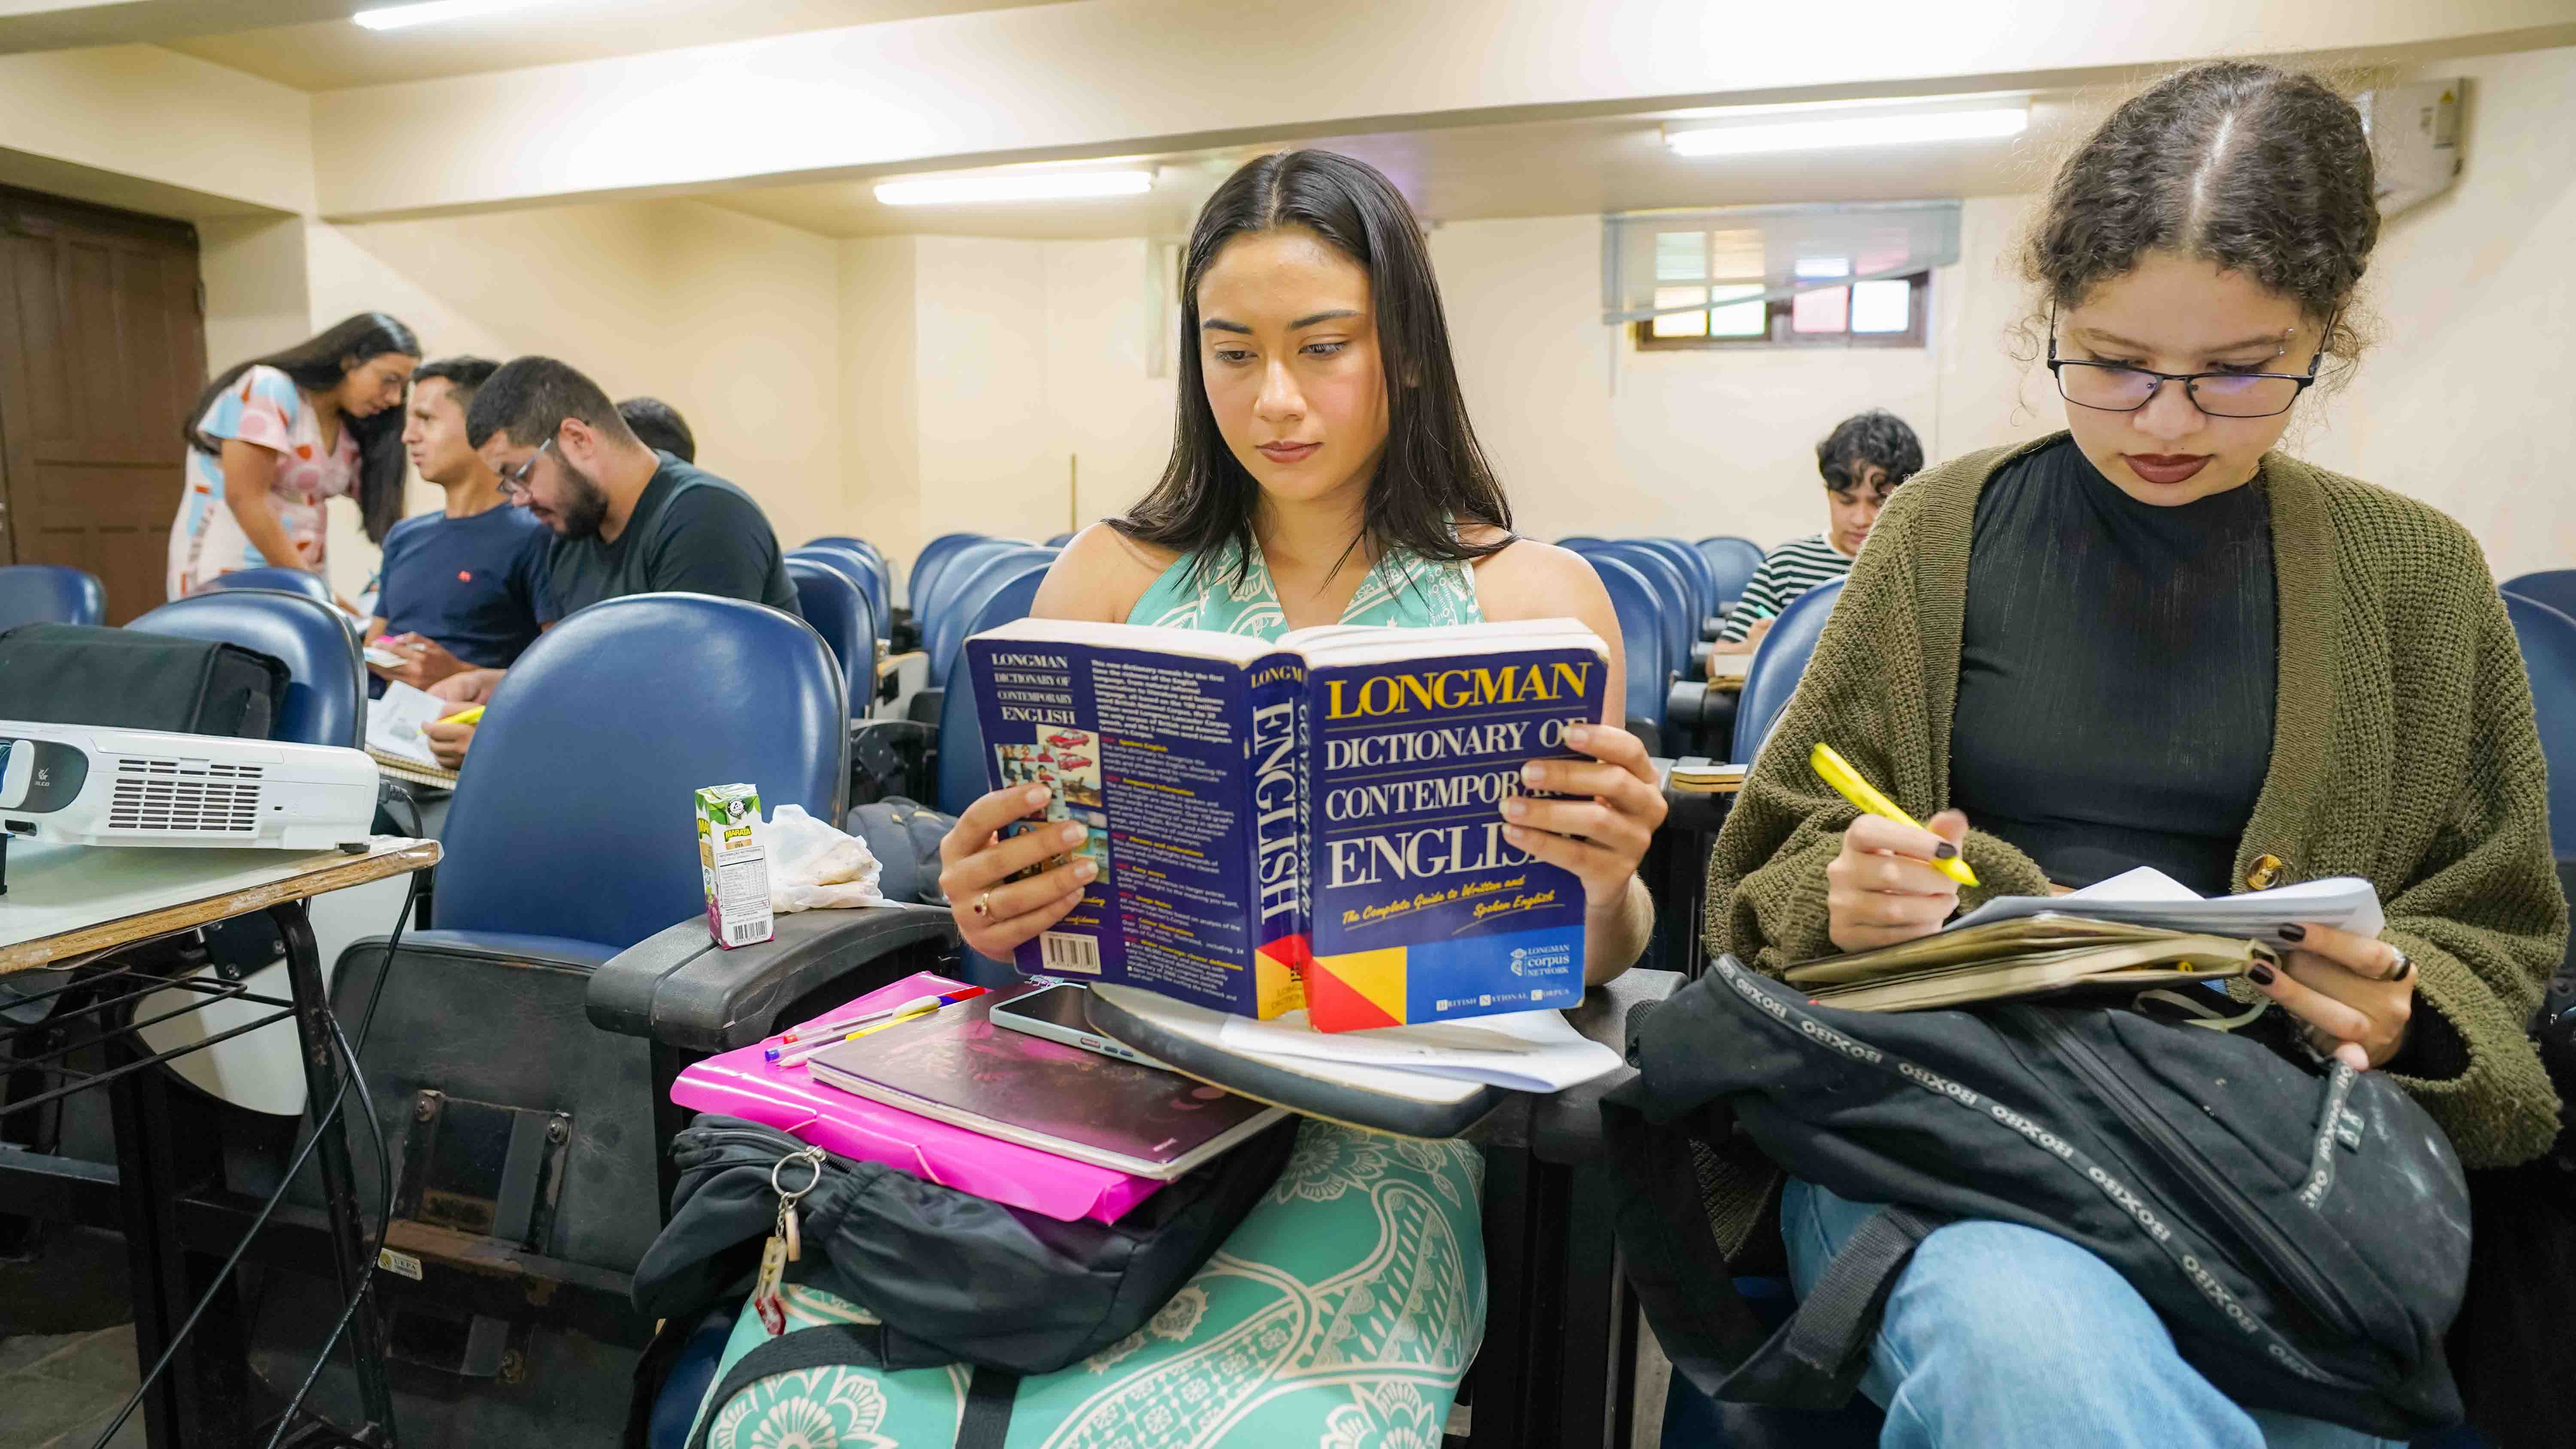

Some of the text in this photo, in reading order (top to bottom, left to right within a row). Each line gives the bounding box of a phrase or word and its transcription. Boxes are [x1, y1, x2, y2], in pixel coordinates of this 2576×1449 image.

[990, 653, 1068, 669] LONGMAN
[995, 673, 1071, 687] DICTIONARY OF
[1251, 666, 1303, 688] LONGM
[1325, 662, 1593, 719] LONGMAN
[1001, 706, 1076, 725] ENGLISH
[1325, 721, 1530, 770] DICTIONARY
[1325, 771, 1563, 822] CONTEMPOR
[1253, 697, 1300, 925] ENGLISH
[1343, 875, 1525, 924] The Complete Guide to Written and
[1473, 889, 1555, 918] Spoken English
[1528, 944, 1570, 955] LONGMAN
[1527, 966, 1569, 977] NETWORK
[1528, 955, 1570, 967] corpus
